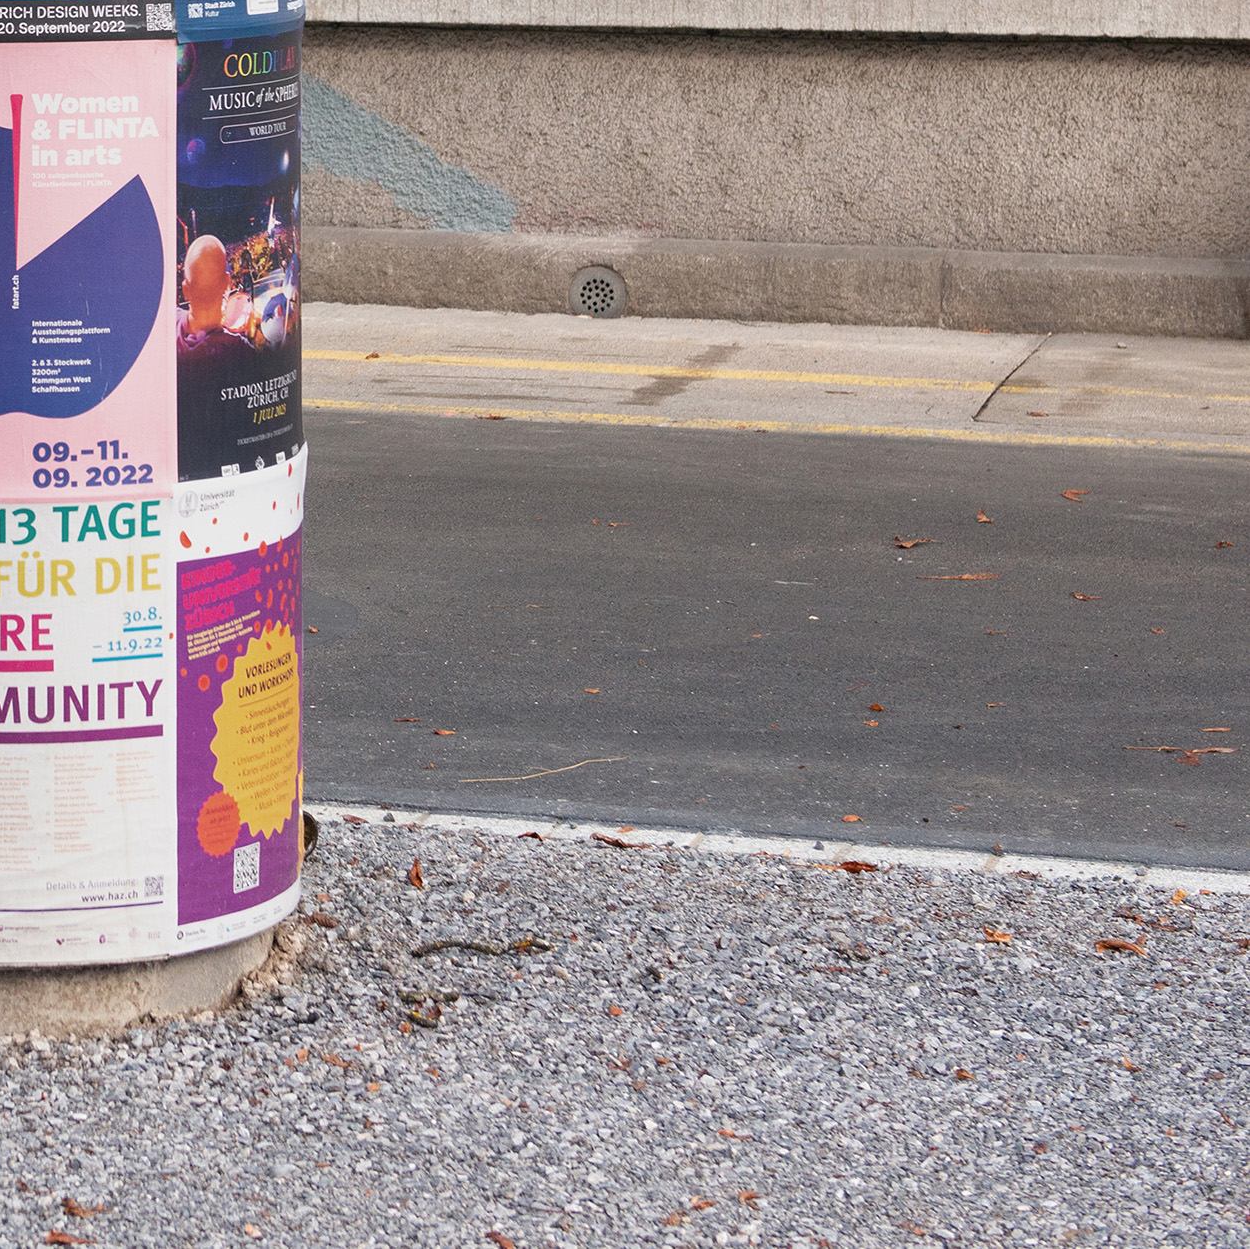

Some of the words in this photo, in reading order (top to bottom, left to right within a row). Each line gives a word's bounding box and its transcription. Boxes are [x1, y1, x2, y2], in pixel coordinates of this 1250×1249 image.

[37, 5, 89, 19] DESIGN
[91, 4, 142, 18] WEEKS.
[204, 2, 219, 10] Stadt
[220, 1, 236, 9] Zürich
[19, 21, 91, 37] September
[93, 20, 126, 33] 2022
[32, 93, 138, 114] Women
[209, 90, 255, 112] MUSIC
[256, 88, 265, 108] of
[265, 87, 275, 103] the
[32, 119, 51, 141] &
[58, 117, 159, 140] FLINTA
[249, 124, 273, 137] WORLD
[273, 121, 287, 134] TOUR
[32, 145, 58, 166] in
[65, 146, 122, 166] arts
[12, 274, 20, 310] fatart.ch
[32, 327, 111, 336] Ausstellungsplattform
[39, 336, 82, 344] Kunstmesse
[54, 358, 92, 367] Stockwerk
[32, 377, 72, 385] Kammgarn
[73, 376, 92, 384] West
[32, 385, 80, 393] Schaffhausen
[220, 382, 264, 401] STADION
[280, 386, 289, 400] CH
[258, 406, 274, 425] JULI
[32, 468, 78, 489] 09.
[86, 464, 154, 487] 2022
[200, 489, 236, 502] Universität
[200, 502, 220, 512] Zürich
[53, 500, 161, 543] TAGE
[95, 553, 162, 595] DIE
[181, 560, 236, 590] KINDER-
[182, 566, 261, 610] UNIVERSITÄT
[122, 606, 163, 626] 30.8.
[184, 601, 235, 631] ZÜRICH
[245, 652, 292, 679] VORLESUNGEN
[238, 684, 258, 699] UND
[46, 880, 77, 891] Details
[87, 878, 140, 890] Anmeldung:
[81, 890, 139, 903] www.haz.ch
